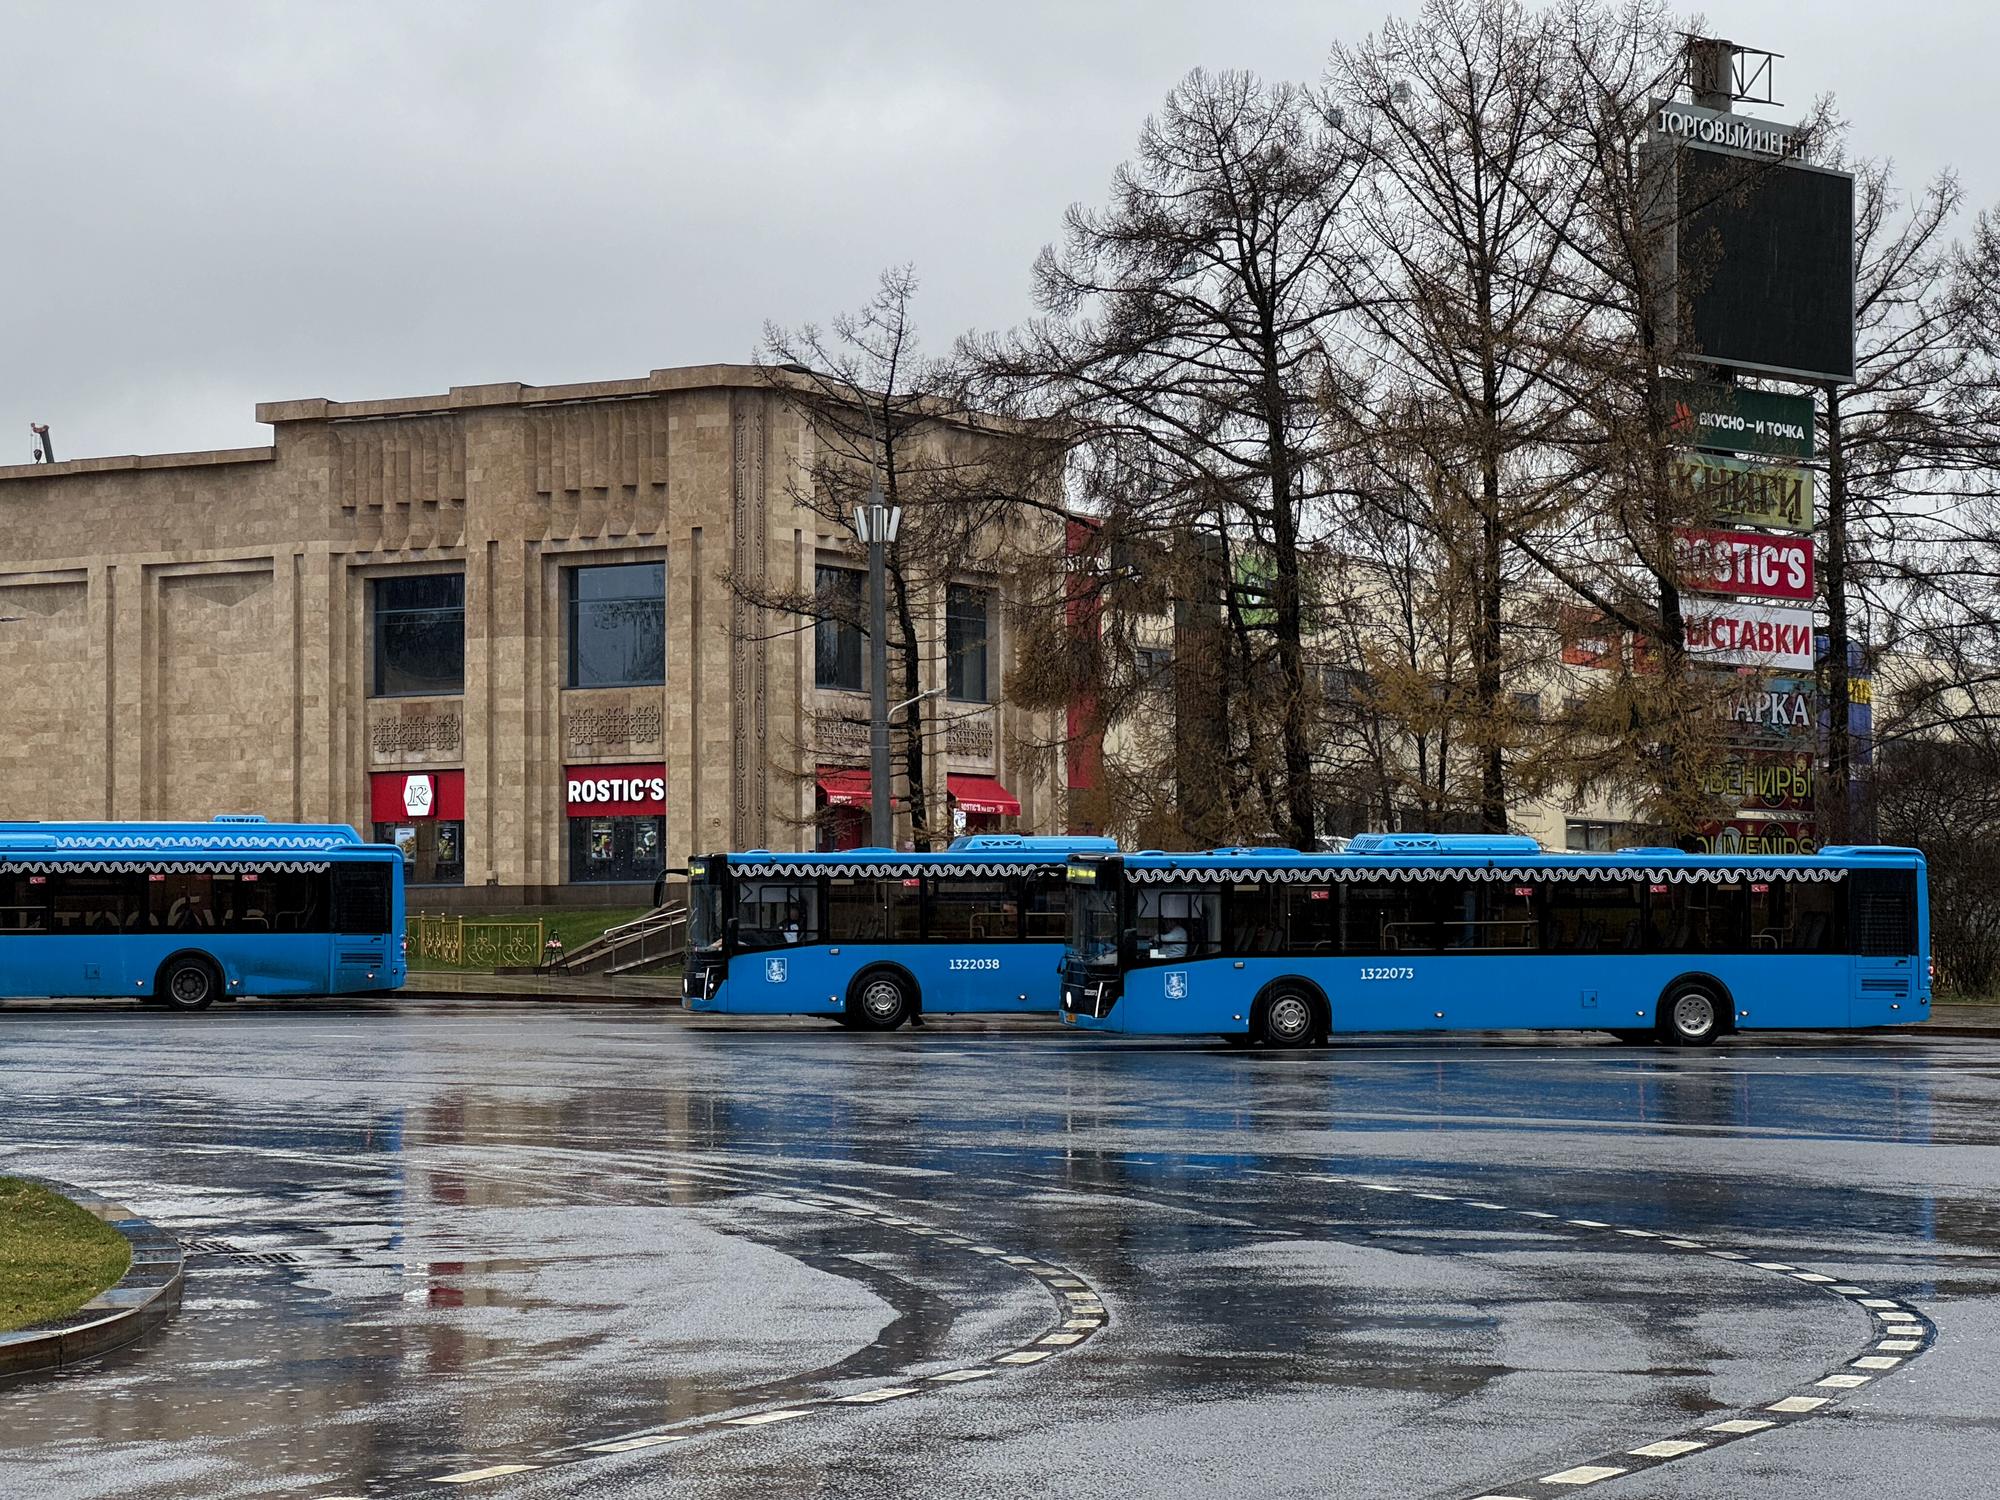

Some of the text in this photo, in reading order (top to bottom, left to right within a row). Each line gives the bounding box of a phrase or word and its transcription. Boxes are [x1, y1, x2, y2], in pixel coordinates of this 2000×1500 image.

[1658, 110, 1805, 160] ТОРГОВЫЙ ЦЕН
[1700, 412, 1744, 432] ВКУСНО
[1767, 421, 1804, 440] ТОЧКА
[1683, 614, 1810, 656] ЫСТАВКИ
[568, 777, 664, 803] ROSTIC'S
[949, 959, 1000, 970] 1322038
[1360, 967, 1414, 980] 1322073
